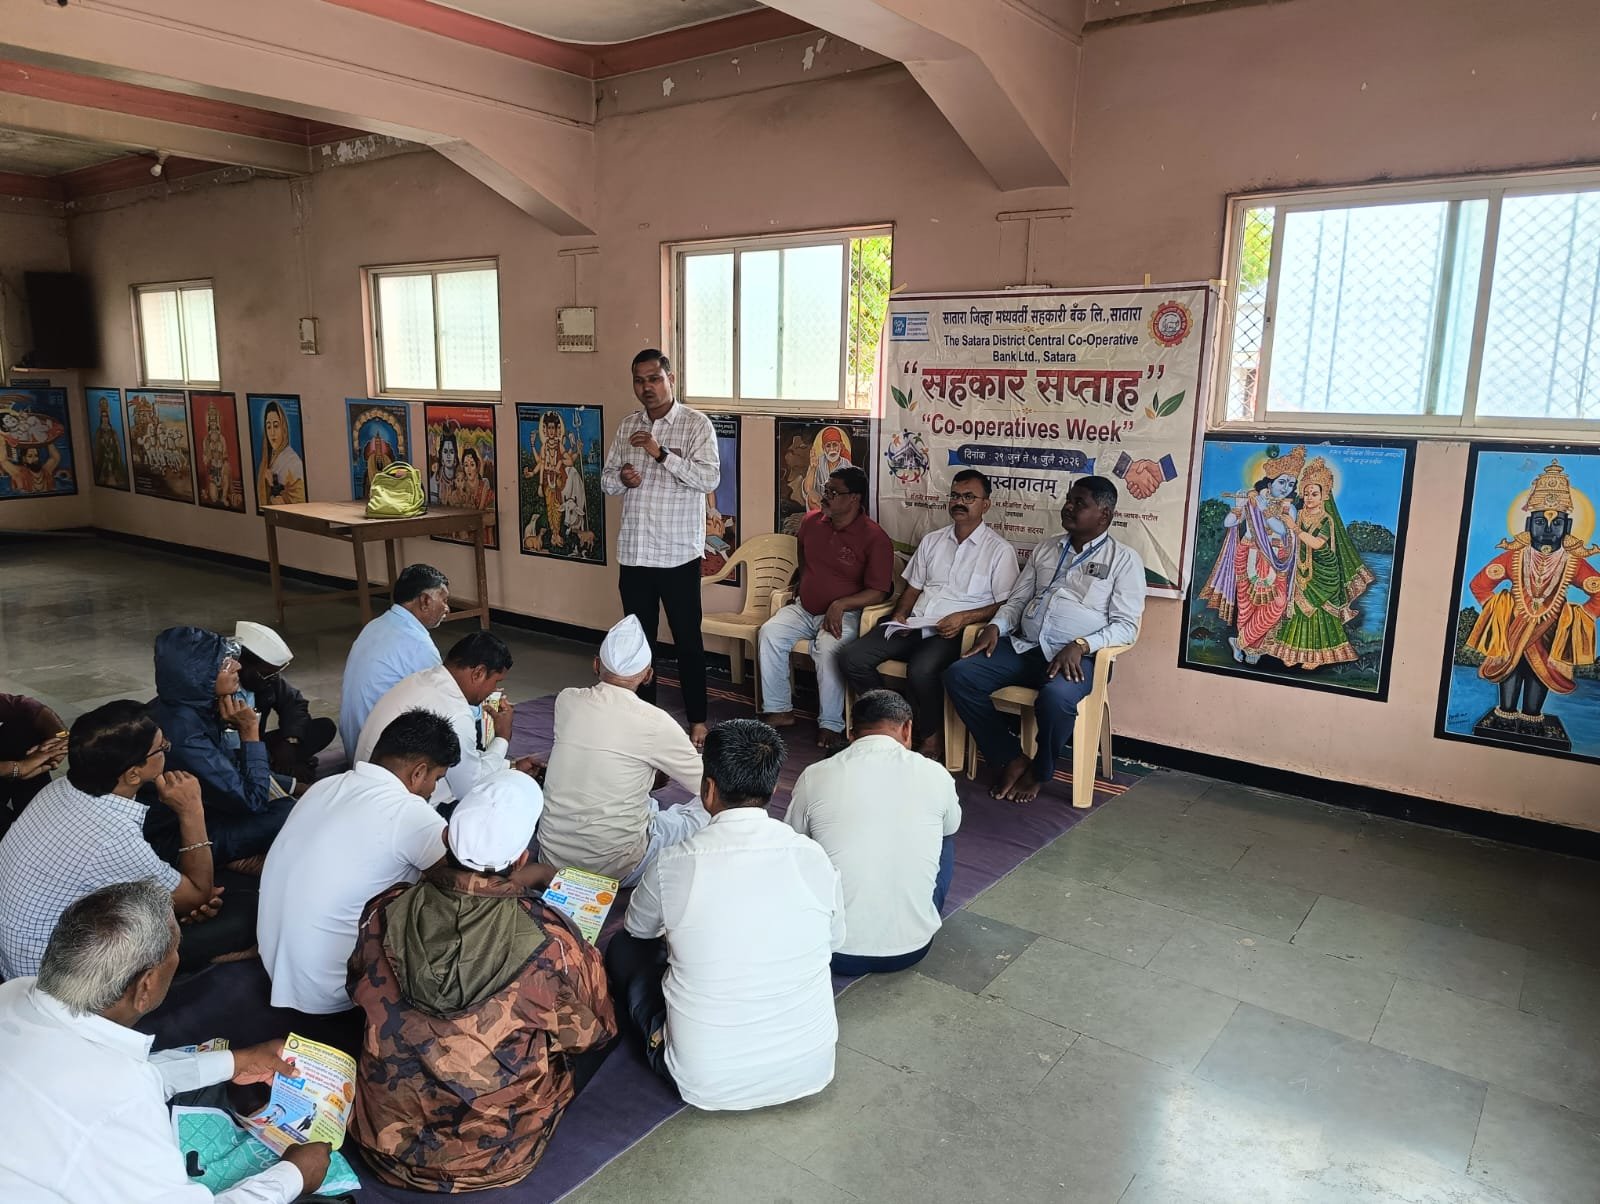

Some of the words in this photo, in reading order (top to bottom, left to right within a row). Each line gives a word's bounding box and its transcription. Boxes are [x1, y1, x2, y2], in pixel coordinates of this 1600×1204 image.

[943, 312, 967, 325] सातारा
[970, 306, 993, 326] जिल्हा
[996, 305, 1028, 325] मध्यवर्ती
[1031, 304, 1067, 325] सहकारी
[944, 335, 959, 345] The
[962, 335, 990, 346] Satara
[993, 335, 1025, 346] District
[1028, 335, 1065, 346] Central
[1068, 334, 1139, 348] Co-Operative
[993, 351, 1016, 362] Bank
[1018, 351, 1041, 363] Ltd.,
[1043, 351, 1076, 363] Satara
[985, 475, 1058, 499] स्वागतम्
